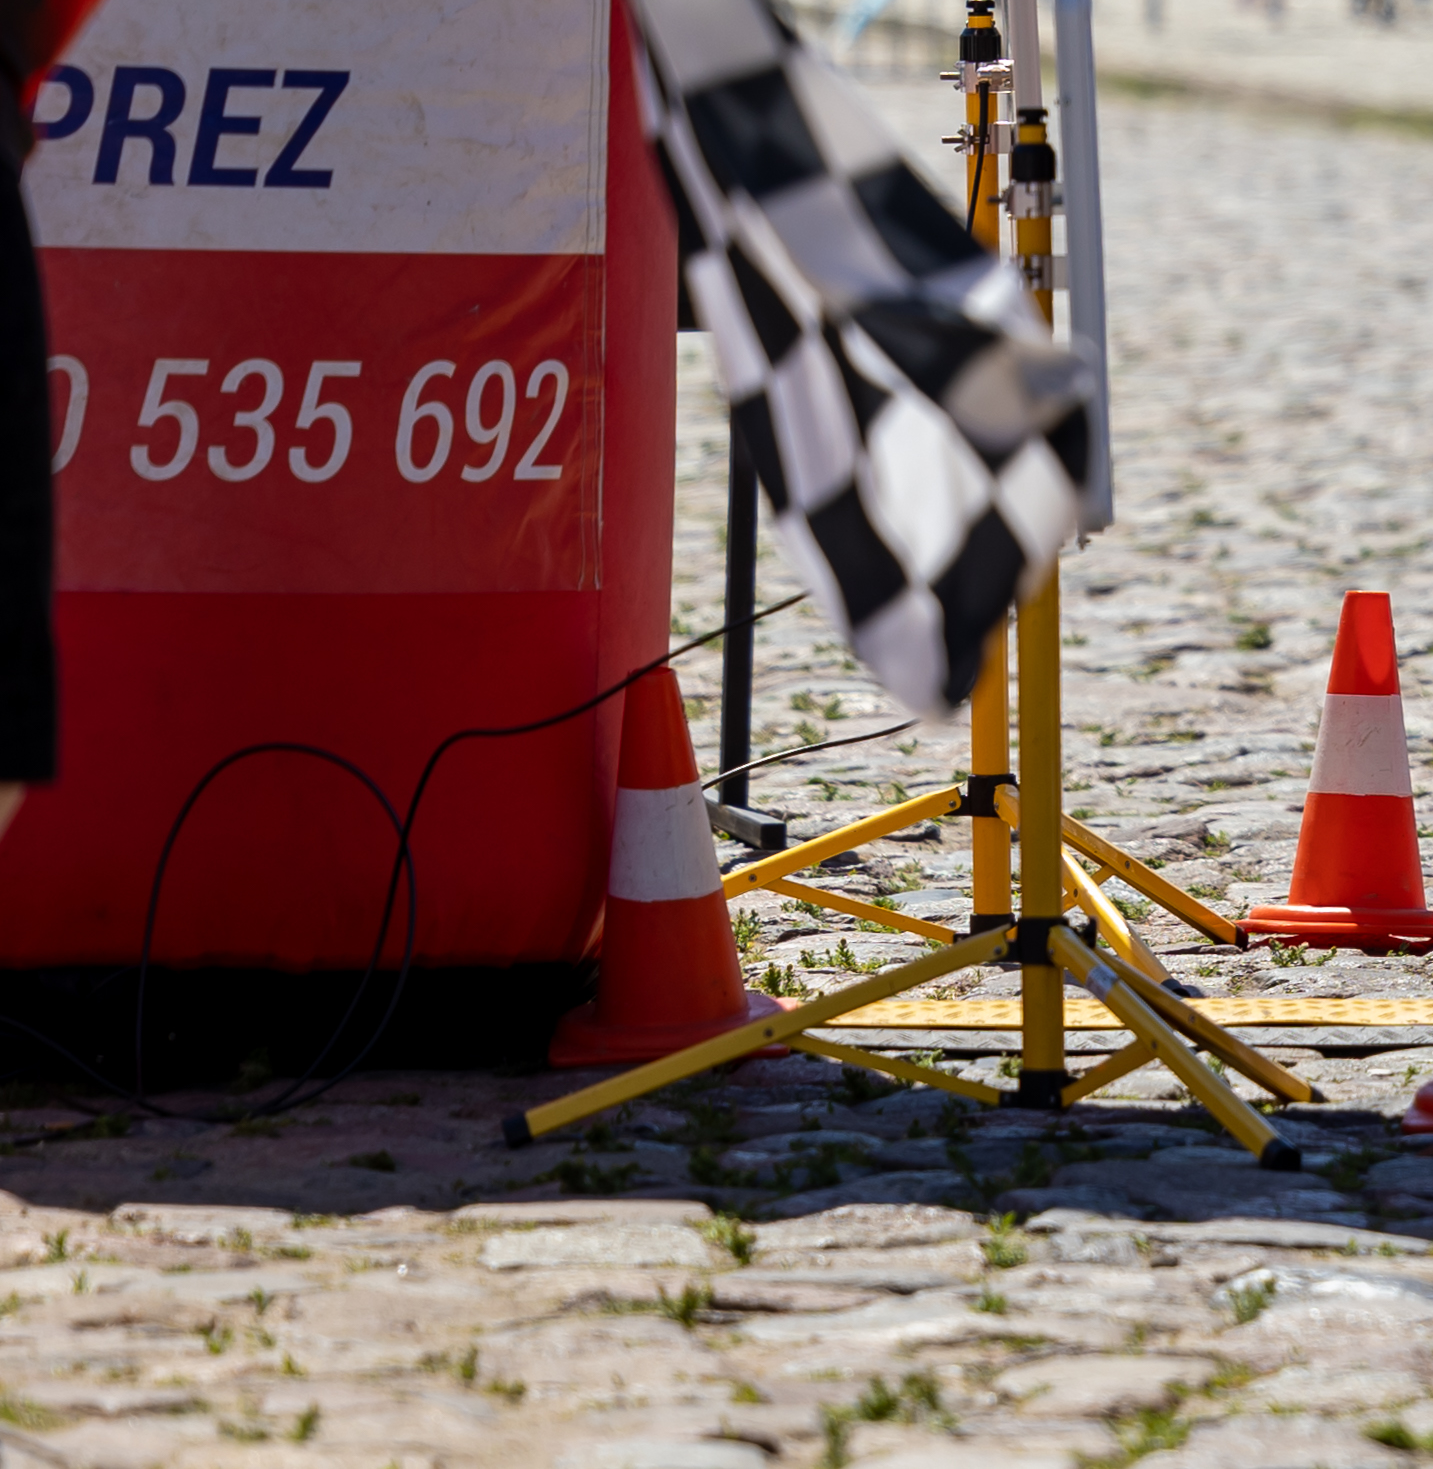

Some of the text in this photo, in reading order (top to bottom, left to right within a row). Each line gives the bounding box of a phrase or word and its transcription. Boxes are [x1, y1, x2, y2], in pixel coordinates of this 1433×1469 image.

[26, 65, 350, 188] PREZ
[129, 358, 362, 483] 535
[394, 359, 569, 483] 692
